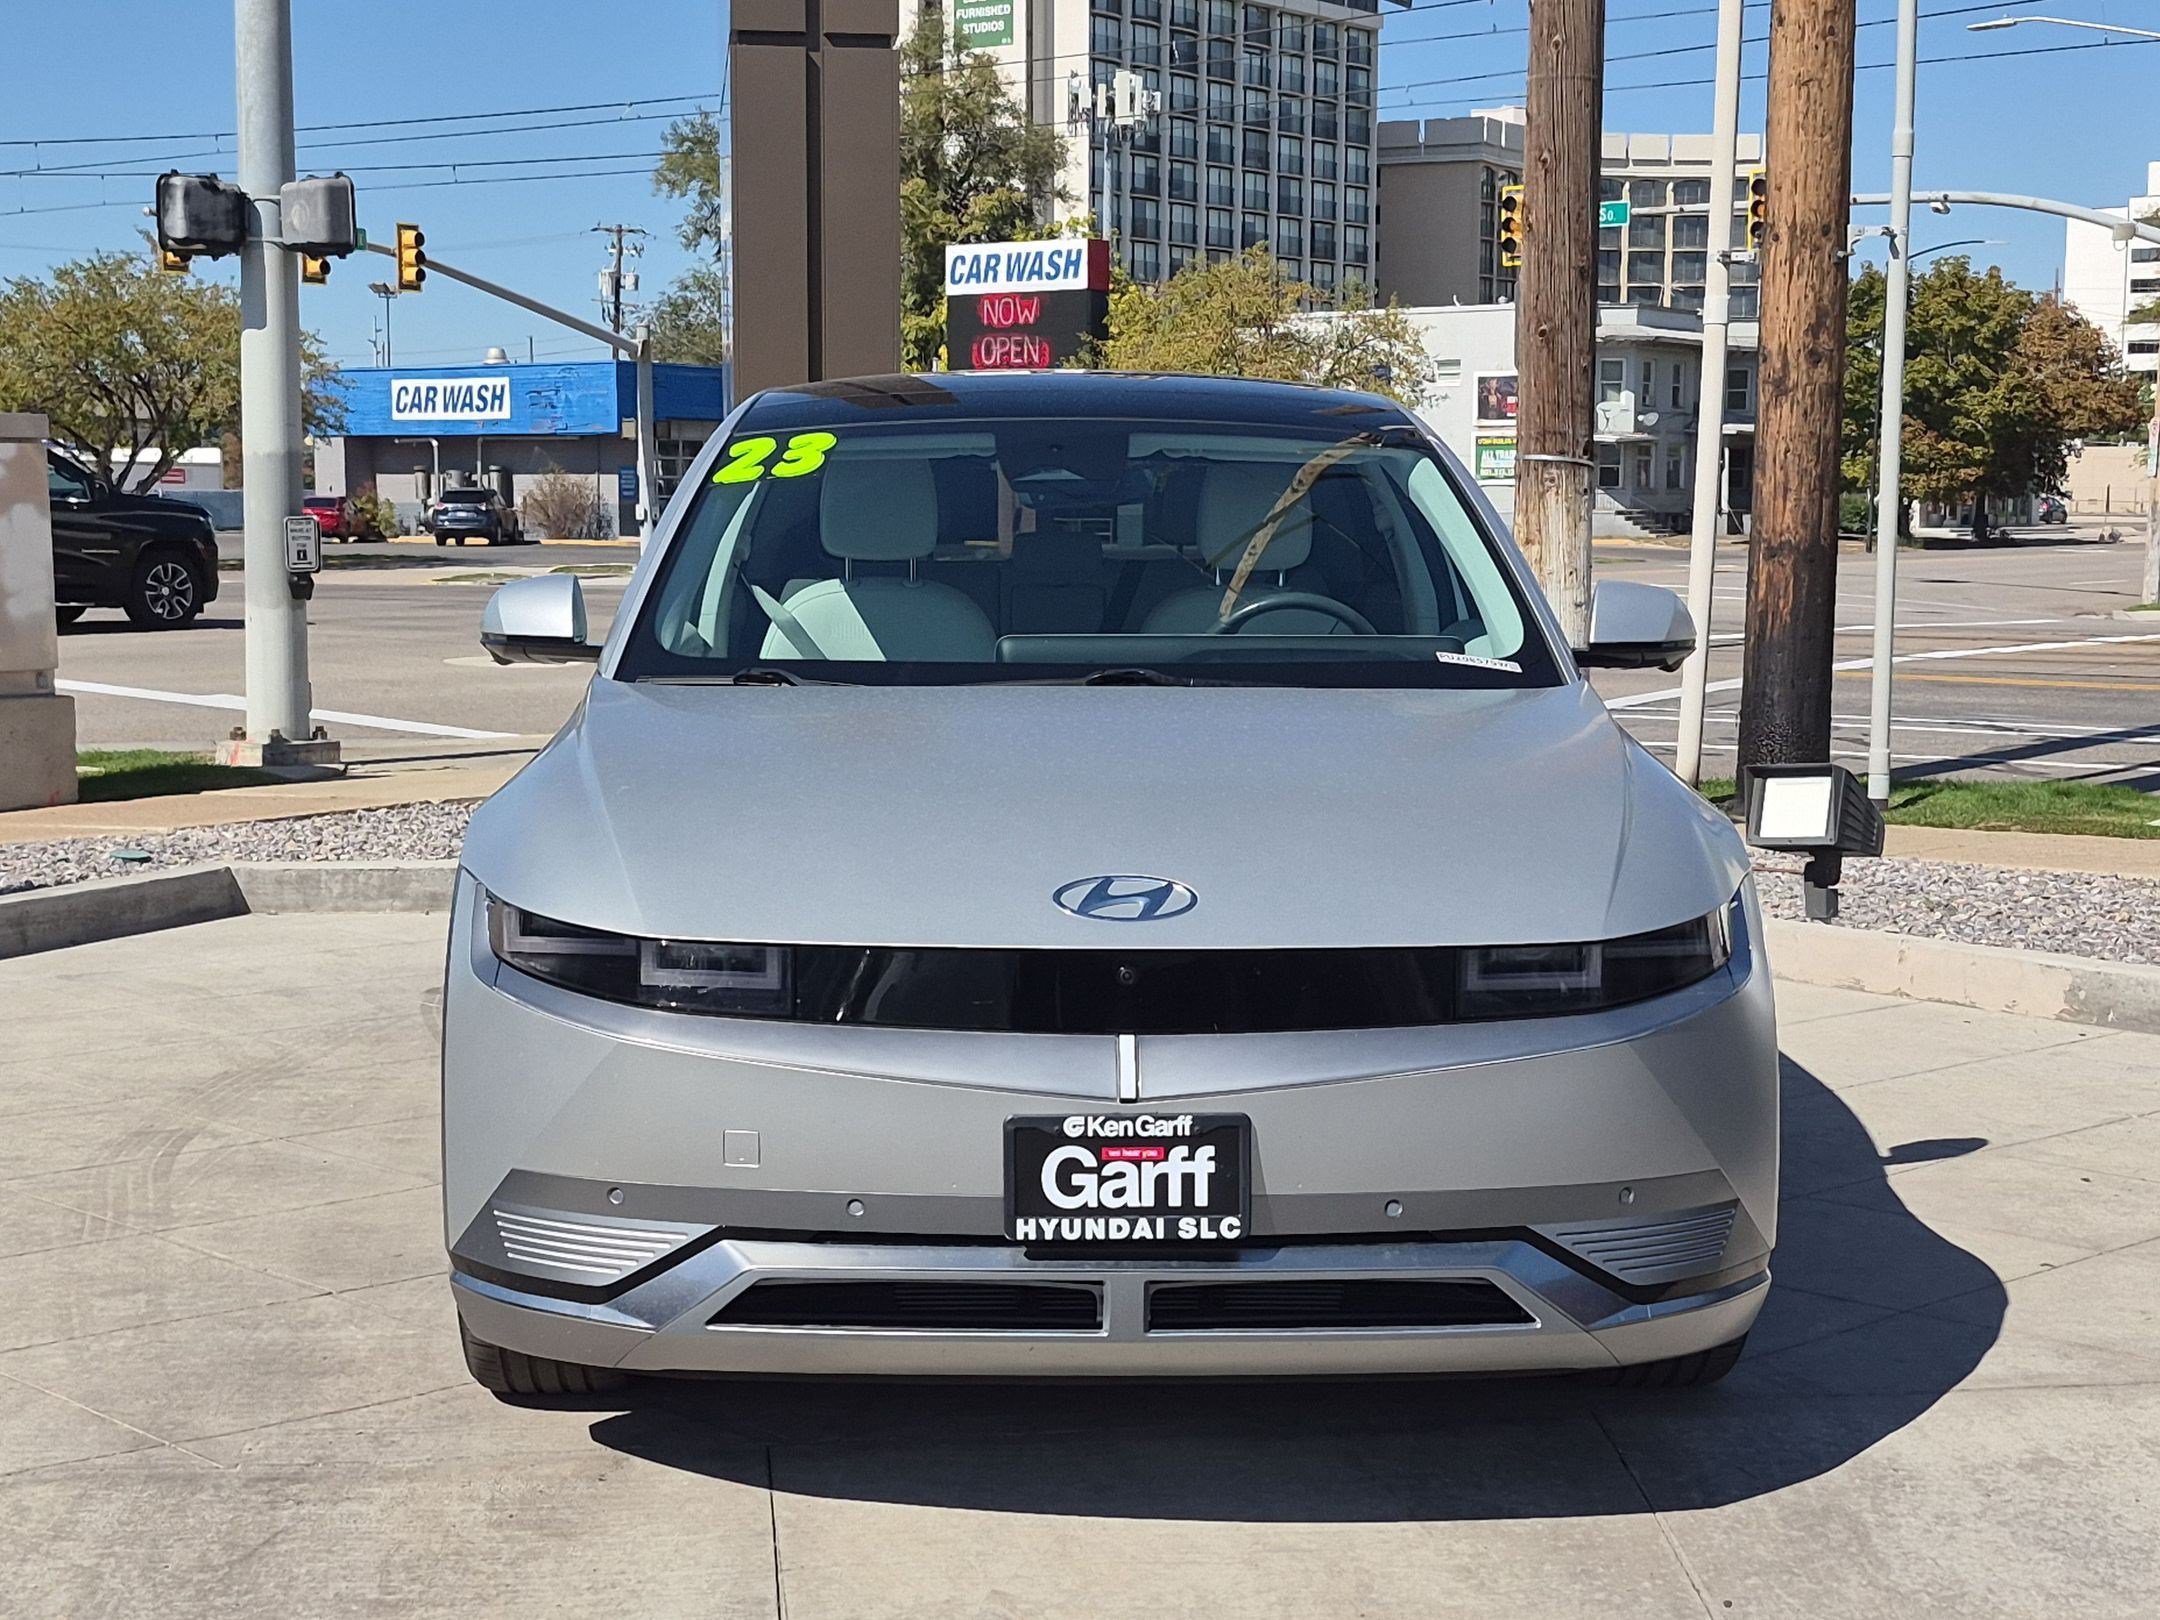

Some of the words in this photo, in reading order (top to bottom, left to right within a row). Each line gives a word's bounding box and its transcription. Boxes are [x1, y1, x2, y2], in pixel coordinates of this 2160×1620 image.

[956, 4, 1011, 19] FURNISHED
[962, 20, 1005, 34] STUDIOS
[950, 253, 1001, 285] CAR
[1005, 248, 1083, 282] WASH
[983, 297, 1038, 326] NOW
[981, 335, 1040, 366] OPEN
[395, 386, 438, 414] CAR
[443, 384, 506, 413] WASH
[712, 432, 837, 484] 23
[1087, 1116, 1133, 1137] Ken
[1135, 1115, 1193, 1137] Garff
[1041, 1145, 1216, 1209] Garff
[1016, 1217, 1165, 1241] HYUNDAI
[1178, 1216, 1241, 1240] SLC
